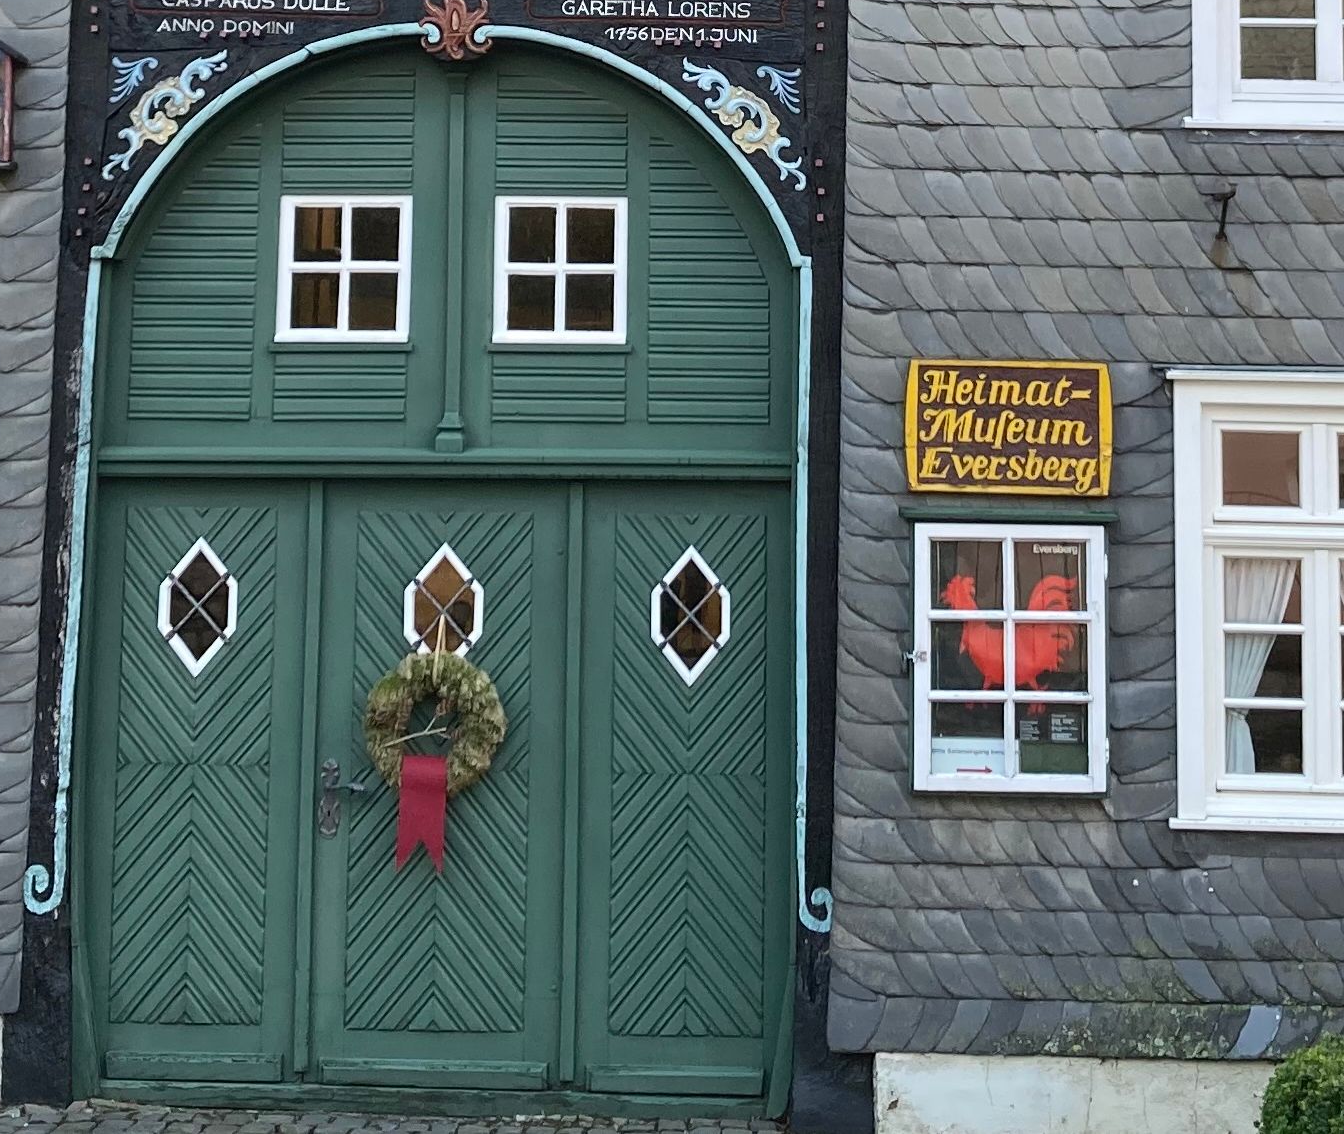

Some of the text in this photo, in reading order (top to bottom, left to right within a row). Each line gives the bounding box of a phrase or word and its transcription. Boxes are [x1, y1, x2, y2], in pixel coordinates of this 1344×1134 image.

[561, 0, 752, 18] GARETHA LORENS
[156, 18, 294, 35] ANNO DOMINI
[604, 26, 649, 41] 1756
[650, 27, 694, 41] DEN
[919, 369, 1093, 407] Heimat-
[918, 447, 1098, 493] Eversberg
